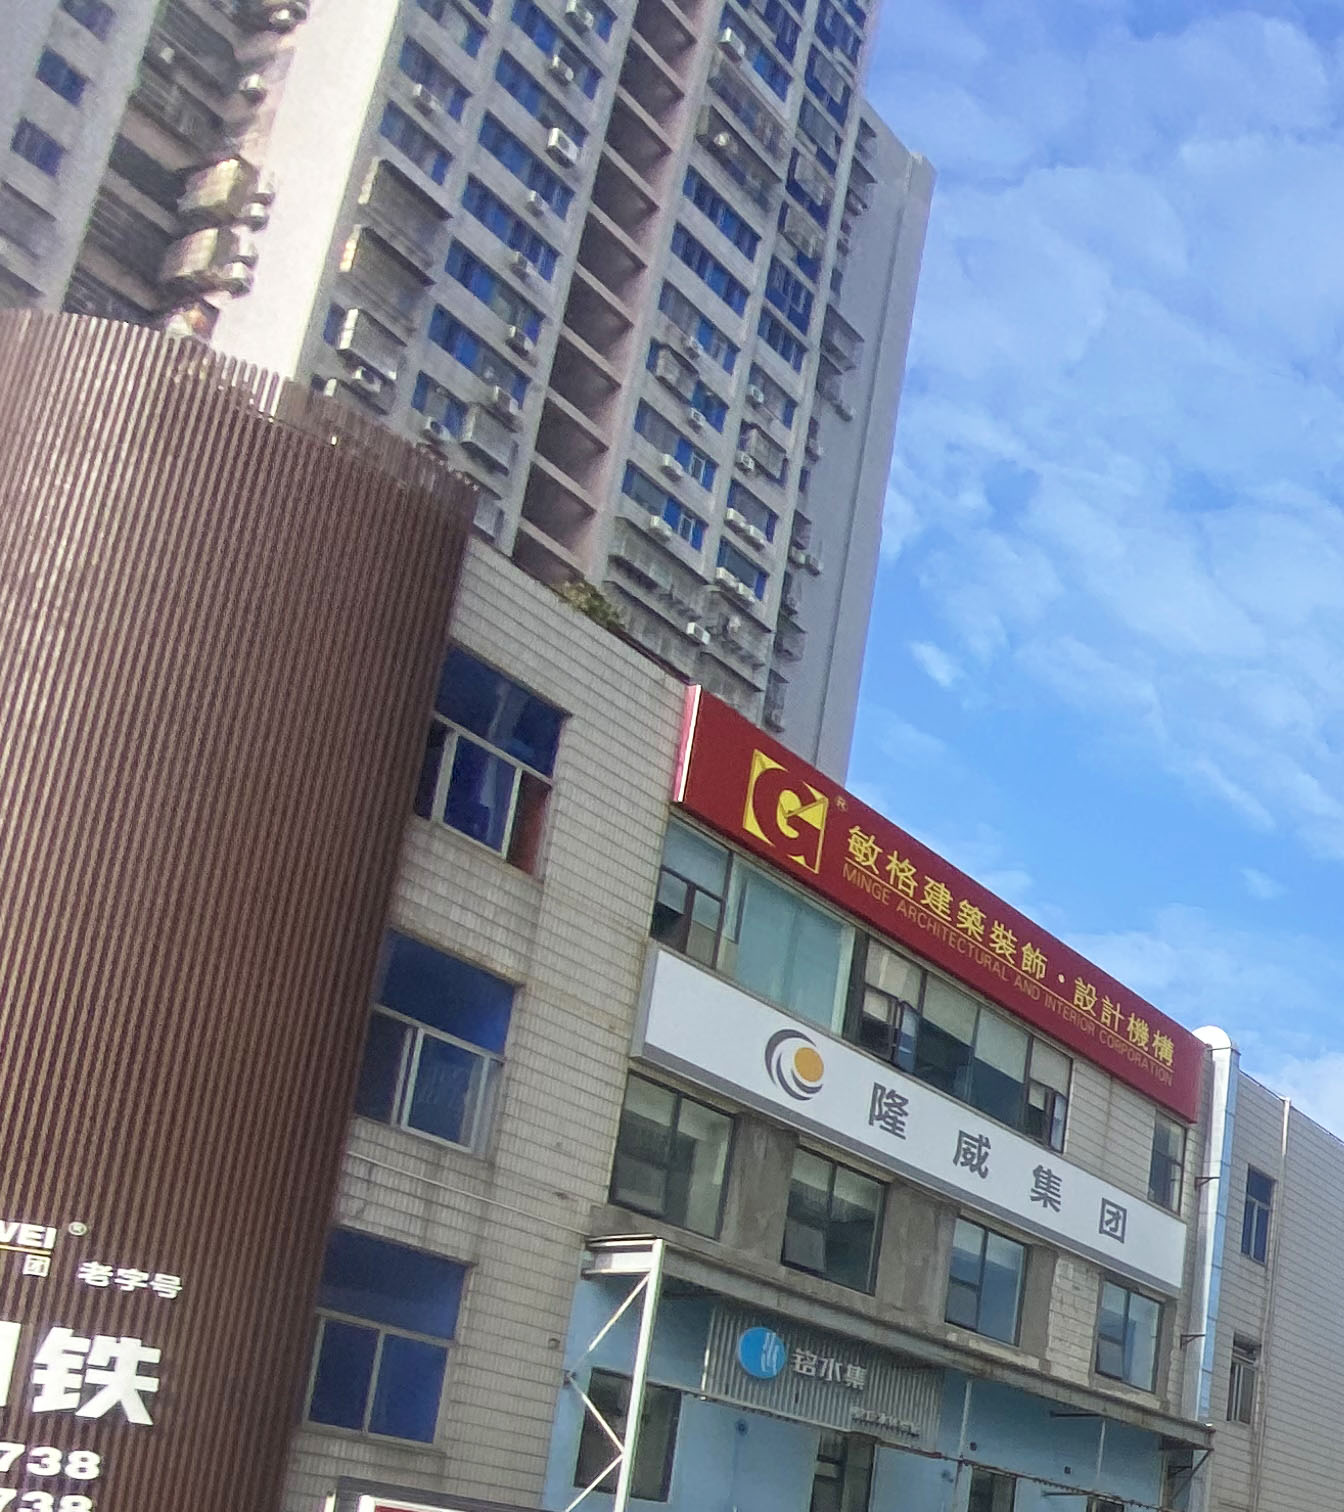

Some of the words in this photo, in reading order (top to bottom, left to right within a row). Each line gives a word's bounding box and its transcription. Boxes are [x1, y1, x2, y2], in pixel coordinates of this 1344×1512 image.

[841, 863, 892, 906] MINGE
[896, 898, 1010, 983] ARCHITECTURAL
[1013, 974, 1042, 1001] AND
[1043, 990, 1097, 1036] INTERIOR
[1098, 1031, 1174, 1087] CORPORATION
[867, 1080, 1128, 1245] 隆威集团
[77, 1261, 184, 1300] 老字号
[0, 1320, 162, 1426] 铁
